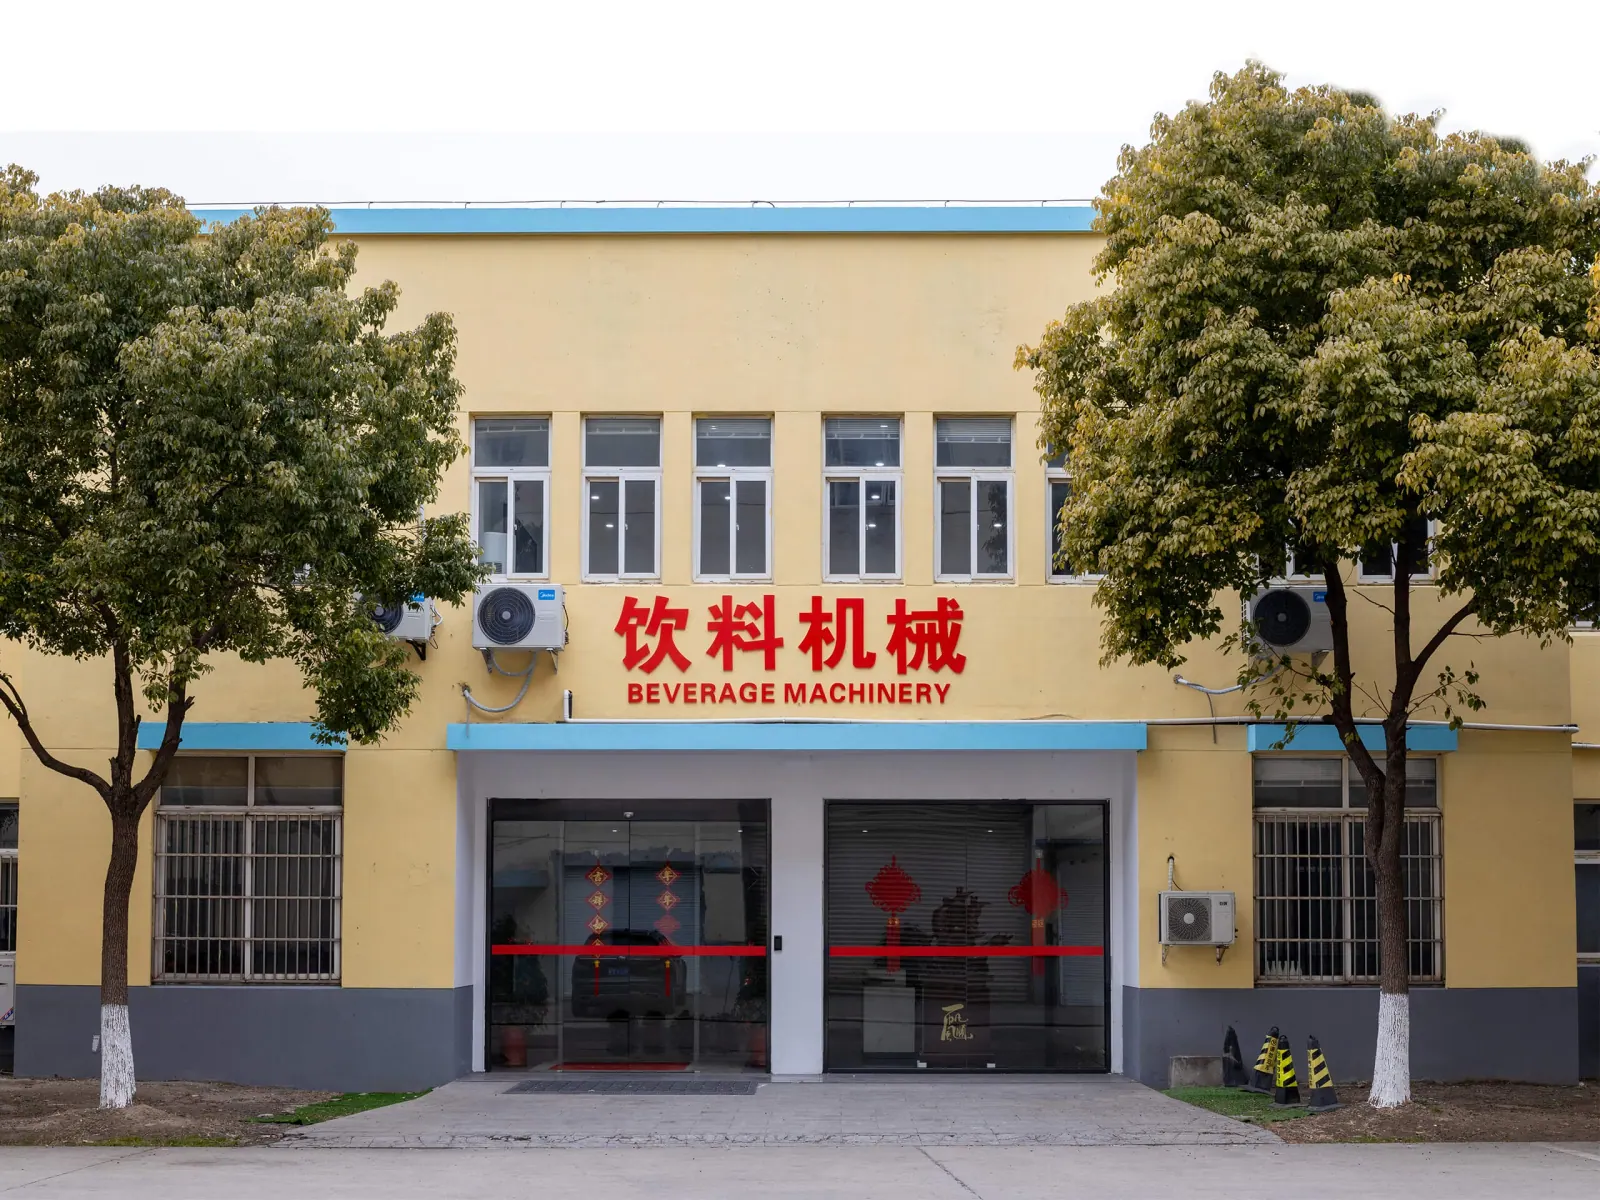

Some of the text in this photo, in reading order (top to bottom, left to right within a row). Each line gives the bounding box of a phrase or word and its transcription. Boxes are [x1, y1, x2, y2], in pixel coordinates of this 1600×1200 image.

[614, 594, 967, 676] 饮料机械
[627, 682, 951, 704] BEVERAGE MACHINERY
